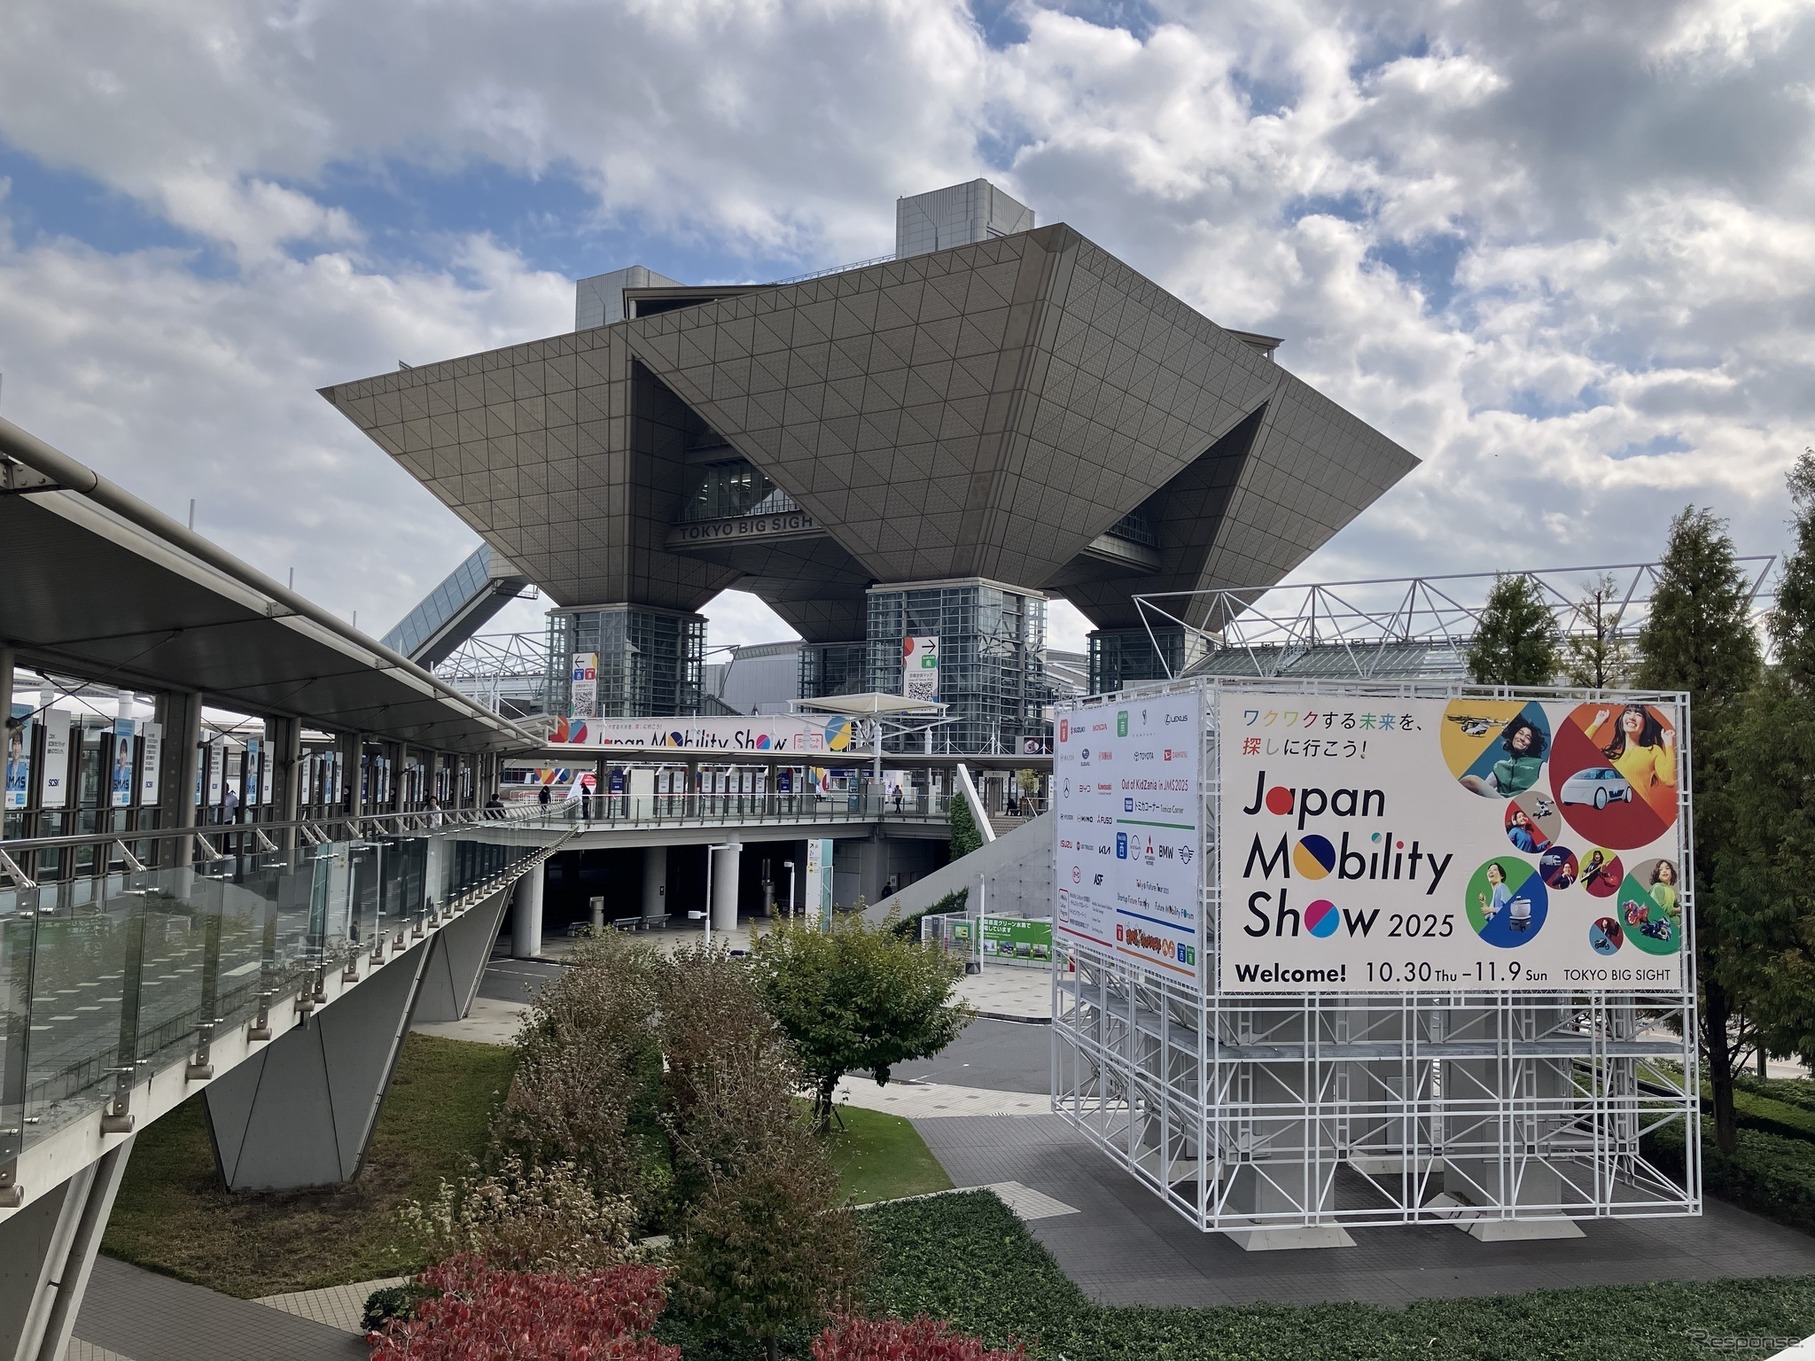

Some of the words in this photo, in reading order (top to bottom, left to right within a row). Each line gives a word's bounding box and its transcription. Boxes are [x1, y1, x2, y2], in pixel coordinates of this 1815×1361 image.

[680, 523, 733, 540] TOKYO
[738, 519, 766, 534] BIG
[772, 515, 813, 531] SIGH
[1243, 709, 1422, 731] ワクワクする未来を、
[1242, 737, 1367, 759] 探しに行こう!
[1130, 780, 1136, 789] of
[1136, 780, 1157, 790] KidZania
[1243, 771, 1385, 830] Japan
[1159, 845, 1173, 859] BMW
[1243, 831, 1453, 895] Mobility
[1243, 888, 1381, 938] Show
[1387, 914, 1454, 937] 2025
[1235, 962, 1346, 982] Welcome!
[1367, 961, 1431, 982] 10.30
[1435, 969, 1457, 982] Thu
[1526, 969, 1548, 981] Sun
[1564, 969, 1608, 981] TOKYO
[1611, 969, 1632, 981] BIG
[1635, 969, 1671, 981] SIGHT
